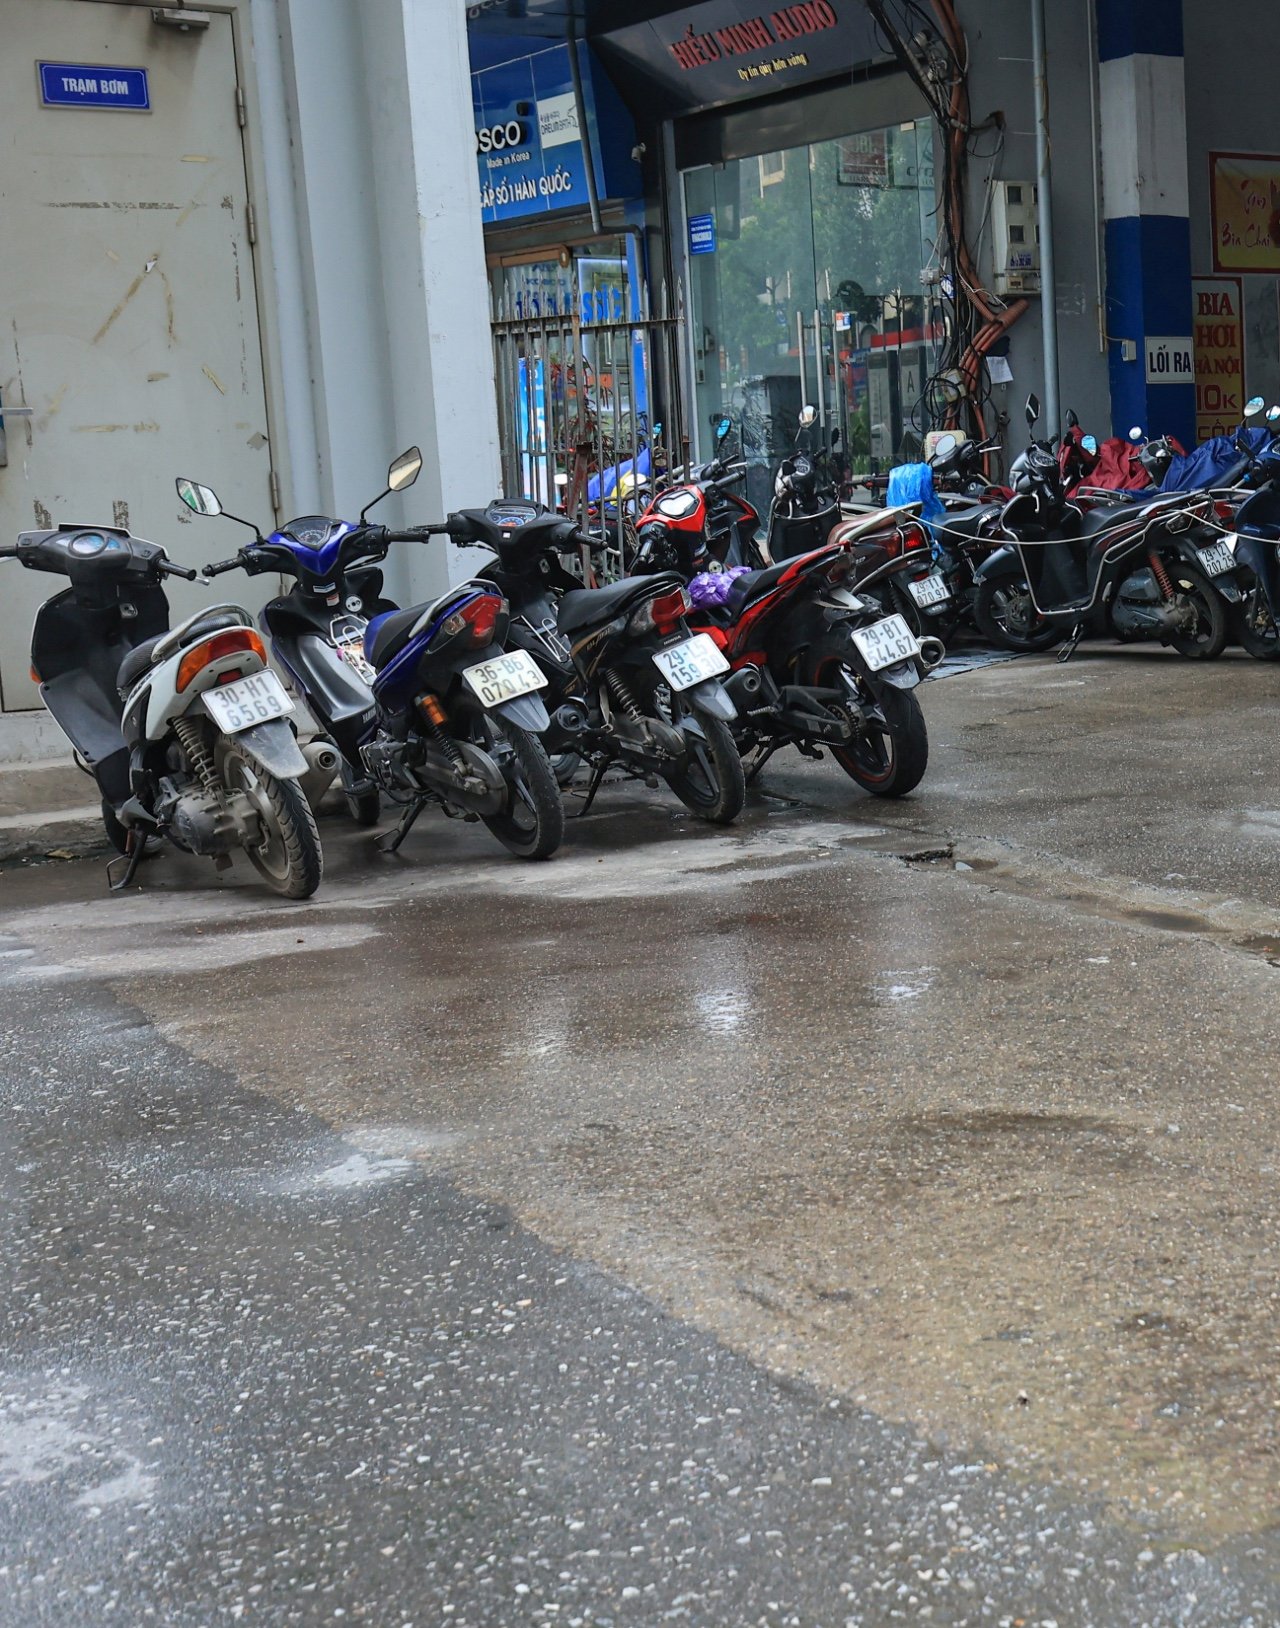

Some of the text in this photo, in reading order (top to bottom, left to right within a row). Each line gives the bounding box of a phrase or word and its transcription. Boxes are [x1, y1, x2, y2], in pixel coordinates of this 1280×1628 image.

[716, 16, 775, 58] MINH
[770, 0, 838, 42] AUDIO
[61, 77, 129, 96] TRẠM BƠM
[511, 151, 531, 164] Korea
[516, 175, 537, 201] HÀN
[539, 164, 572, 195] QUỐC
[1197, 292, 1235, 316] BIA
[1196, 324, 1236, 348] HƠI
[1149, 345, 1191, 373] LỐI RA
[1214, 355, 1240, 378] NỘI
[1196, 384, 1238, 411] 10K
[861, 620, 903, 648] 29-B1
[867, 635, 915, 667] 544.67
[475, 656, 524, 683] 36-B6
[215, 676, 270, 708] 30-H1
[226, 695, 282, 727] 6569
